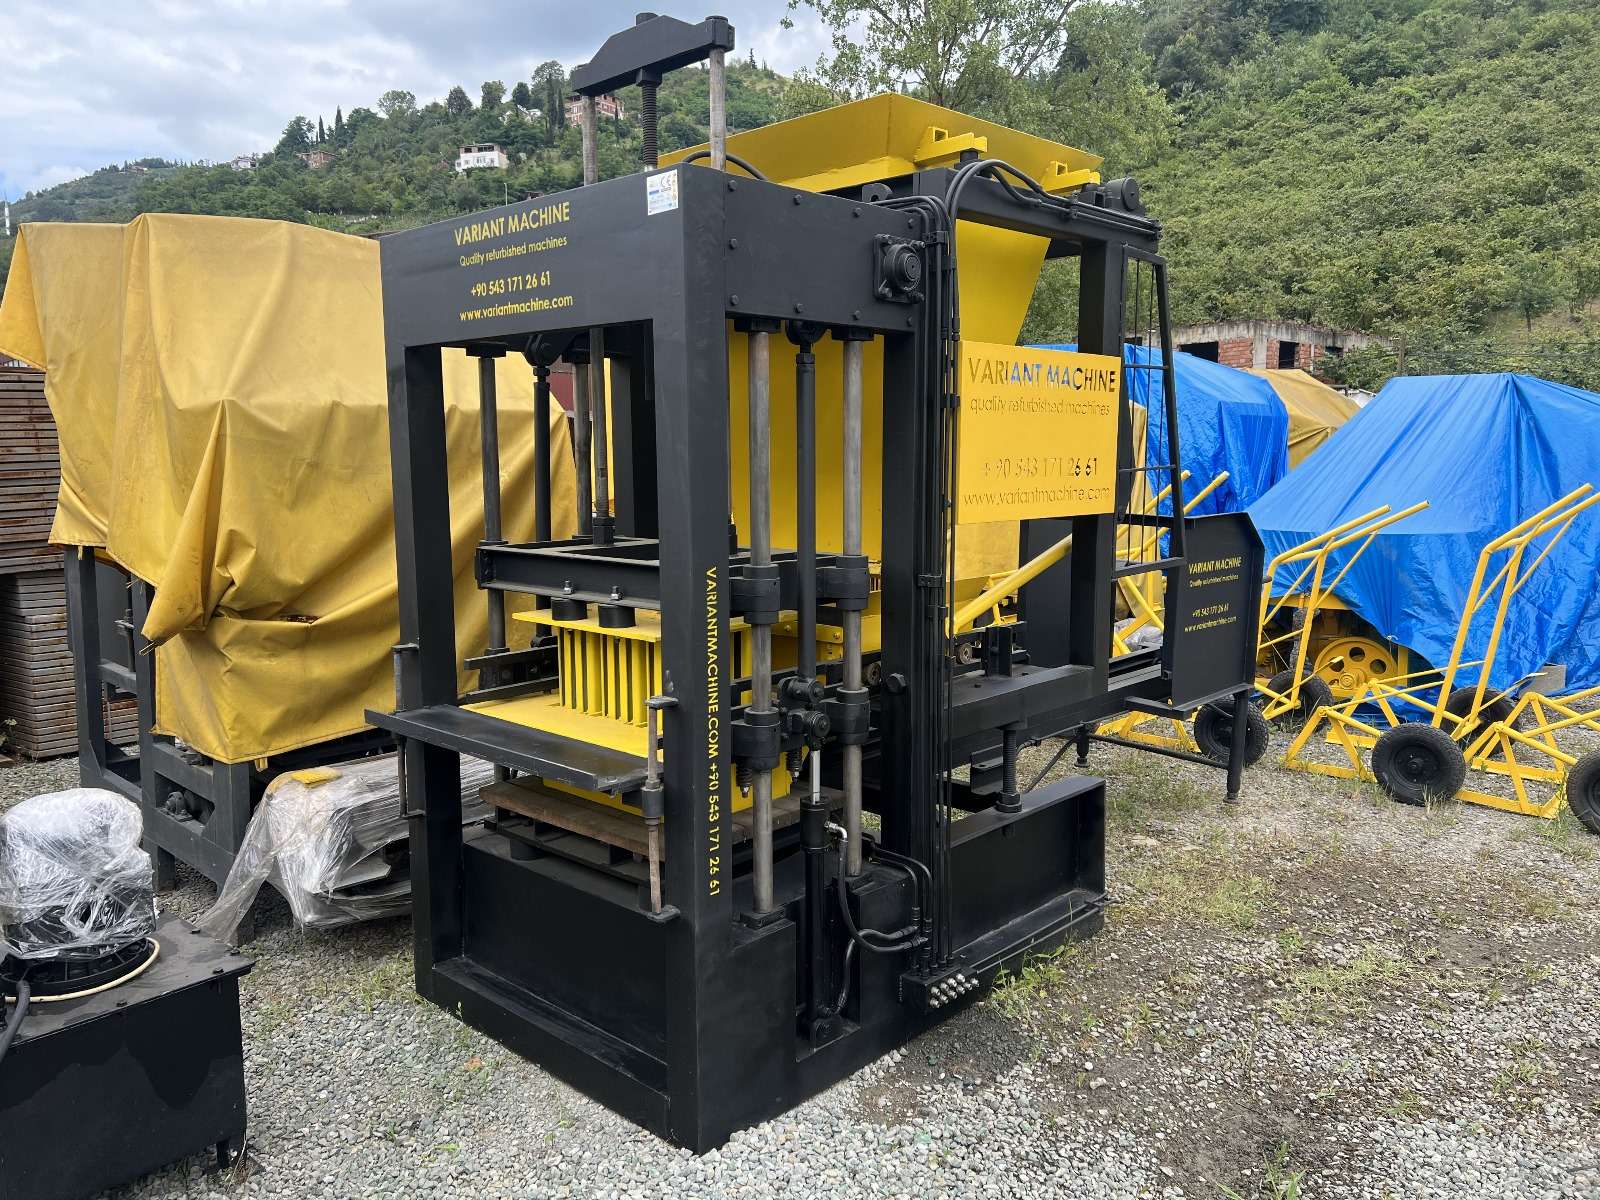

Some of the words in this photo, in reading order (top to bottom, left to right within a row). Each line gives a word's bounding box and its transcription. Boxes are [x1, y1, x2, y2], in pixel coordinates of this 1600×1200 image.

[454, 217, 505, 246] VARIANT
[507, 201, 570, 234] MACHINE
[459, 252, 485, 267] Quality
[486, 242, 527, 261] refurbished
[528, 236, 568, 252] machines
[470, 282, 487, 297] +90
[488, 279, 505, 295] 543
[507, 275, 523, 292] 171
[525, 274, 538, 289] 26
[540, 271, 551, 286] 61
[459, 295, 573, 321] www.variantmachine.com
[968, 357, 1043, 388] VARIANT
[1046, 364, 1116, 393] MACHINE
[970, 394, 1008, 415] quality
[1008, 396, 1064, 415] refurbished
[1065, 399, 1110, 416] machines
[1015, 457, 1038, 477] 543
[1043, 457, 1063, 477] 171
[1064, 457, 1082, 477] 26
[1085, 457, 1098, 476] 61
[963, 485, 1110, 506] www.variantmachine.com
[1189, 561, 1214, 574] VARIANT
[1215, 556, 1241, 570] MACHINE
[706, 566, 719, 759] VARIANTMACHINE.COM
[708, 762, 719, 791] +90
[708, 795, 720, 822] 543
[709, 826, 720, 852] 171
[709, 856, 720, 875] 26
[709, 880, 720, 896] 61
